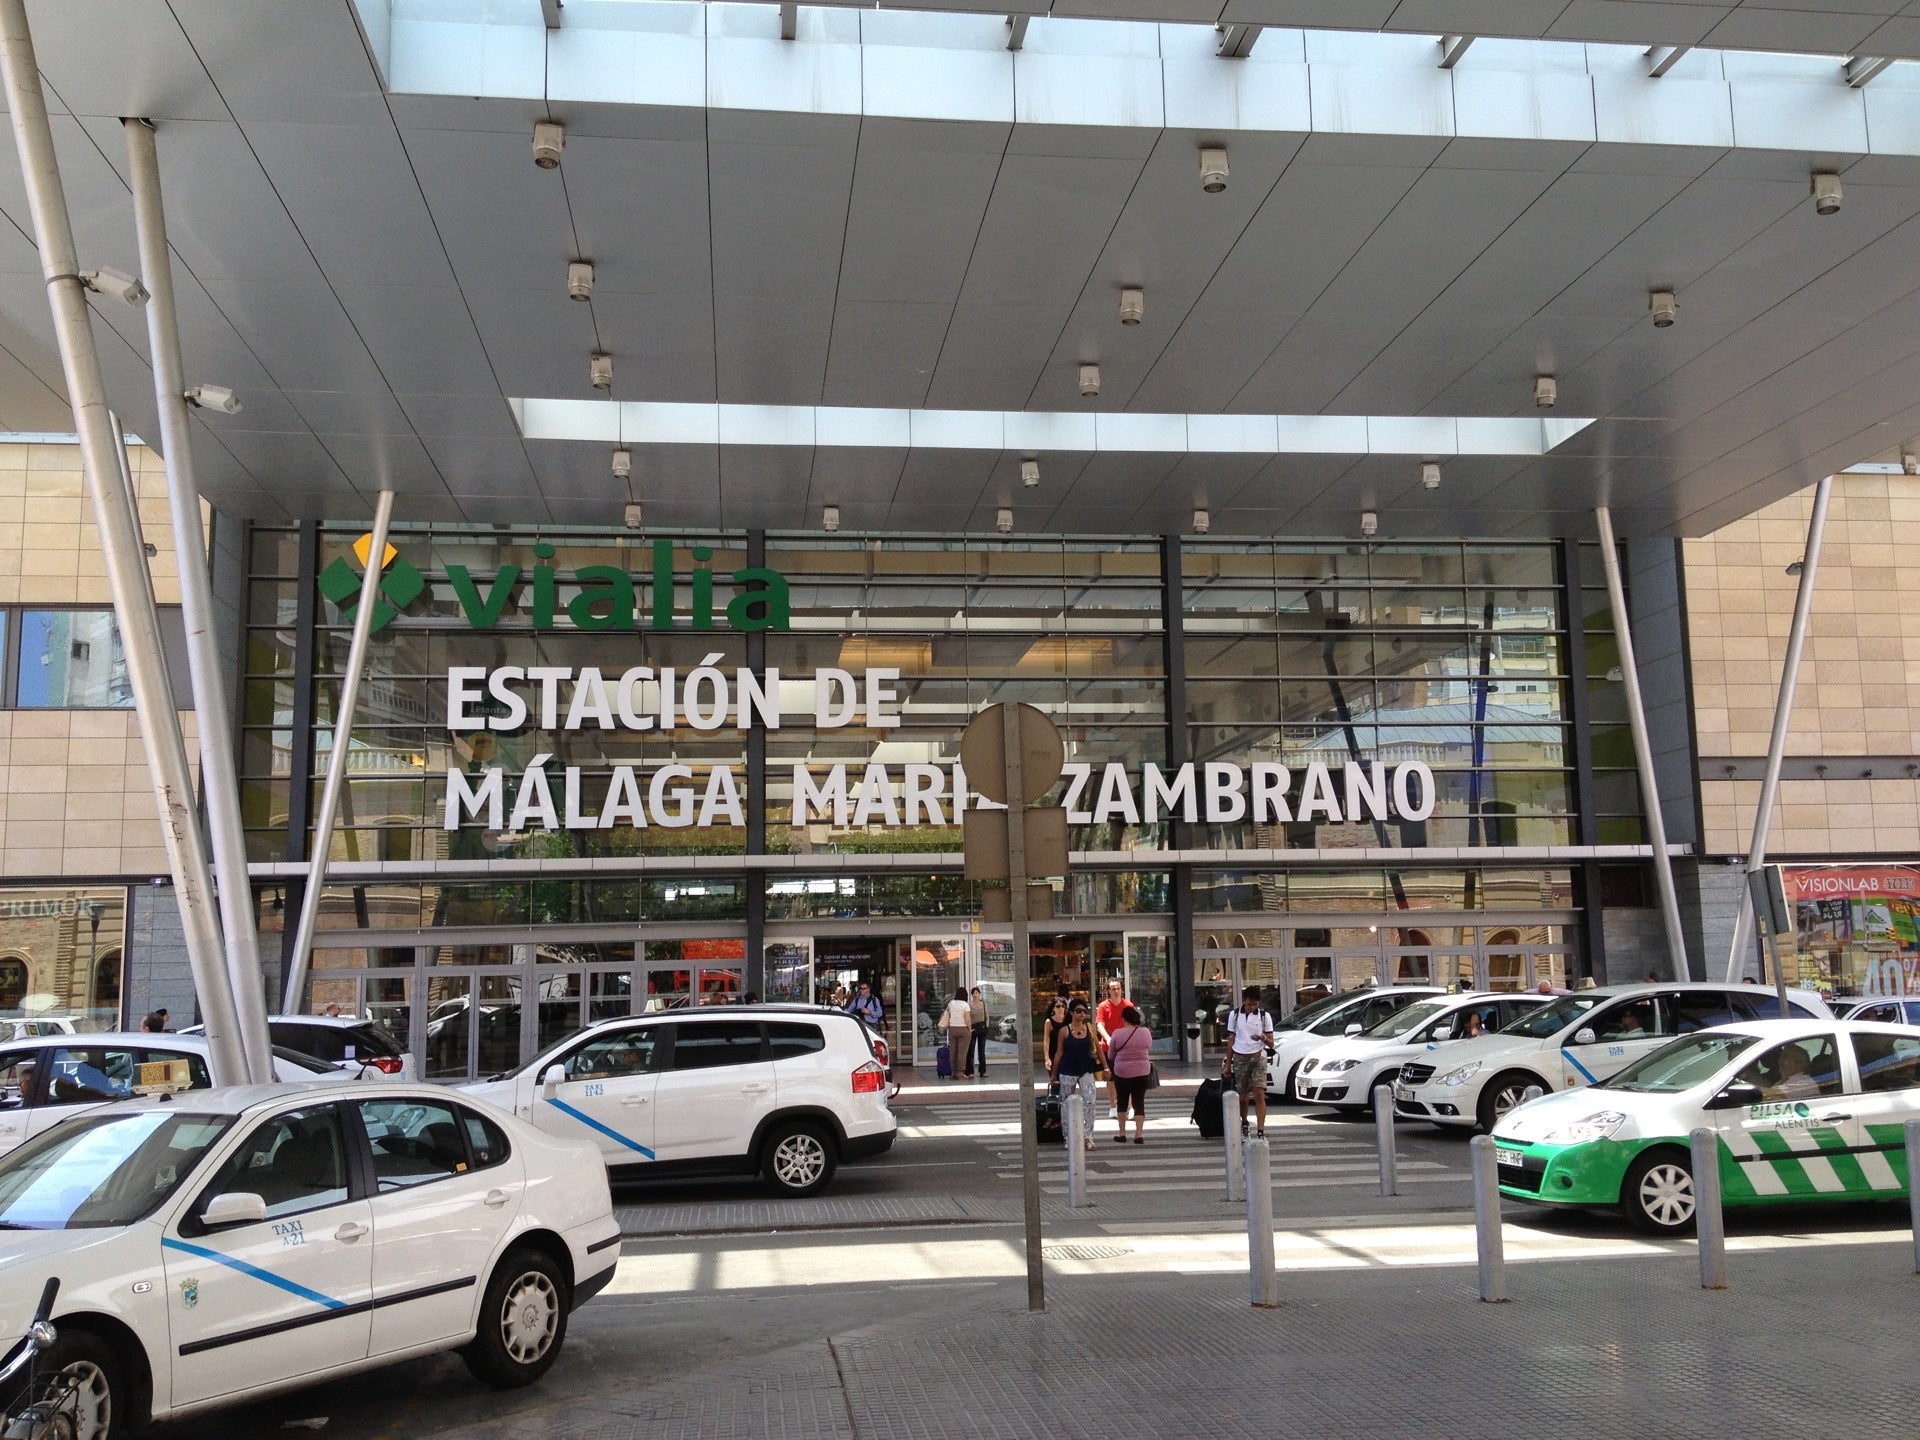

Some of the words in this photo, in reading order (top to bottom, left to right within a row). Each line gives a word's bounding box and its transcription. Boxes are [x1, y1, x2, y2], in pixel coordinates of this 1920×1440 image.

[446, 540, 790, 632] vialia
[446, 652, 780, 731] ESTACIÓN
[816, 667, 902, 729] DE
[444, 753, 746, 831] MÁLAGA
[1061, 760, 1437, 825] ZAMBRANO
[1796, 877, 1879, 892] VISIONLAB
[1750, 1103, 1793, 1117] PILSA
[271, 1220, 304, 1236] TAXI
